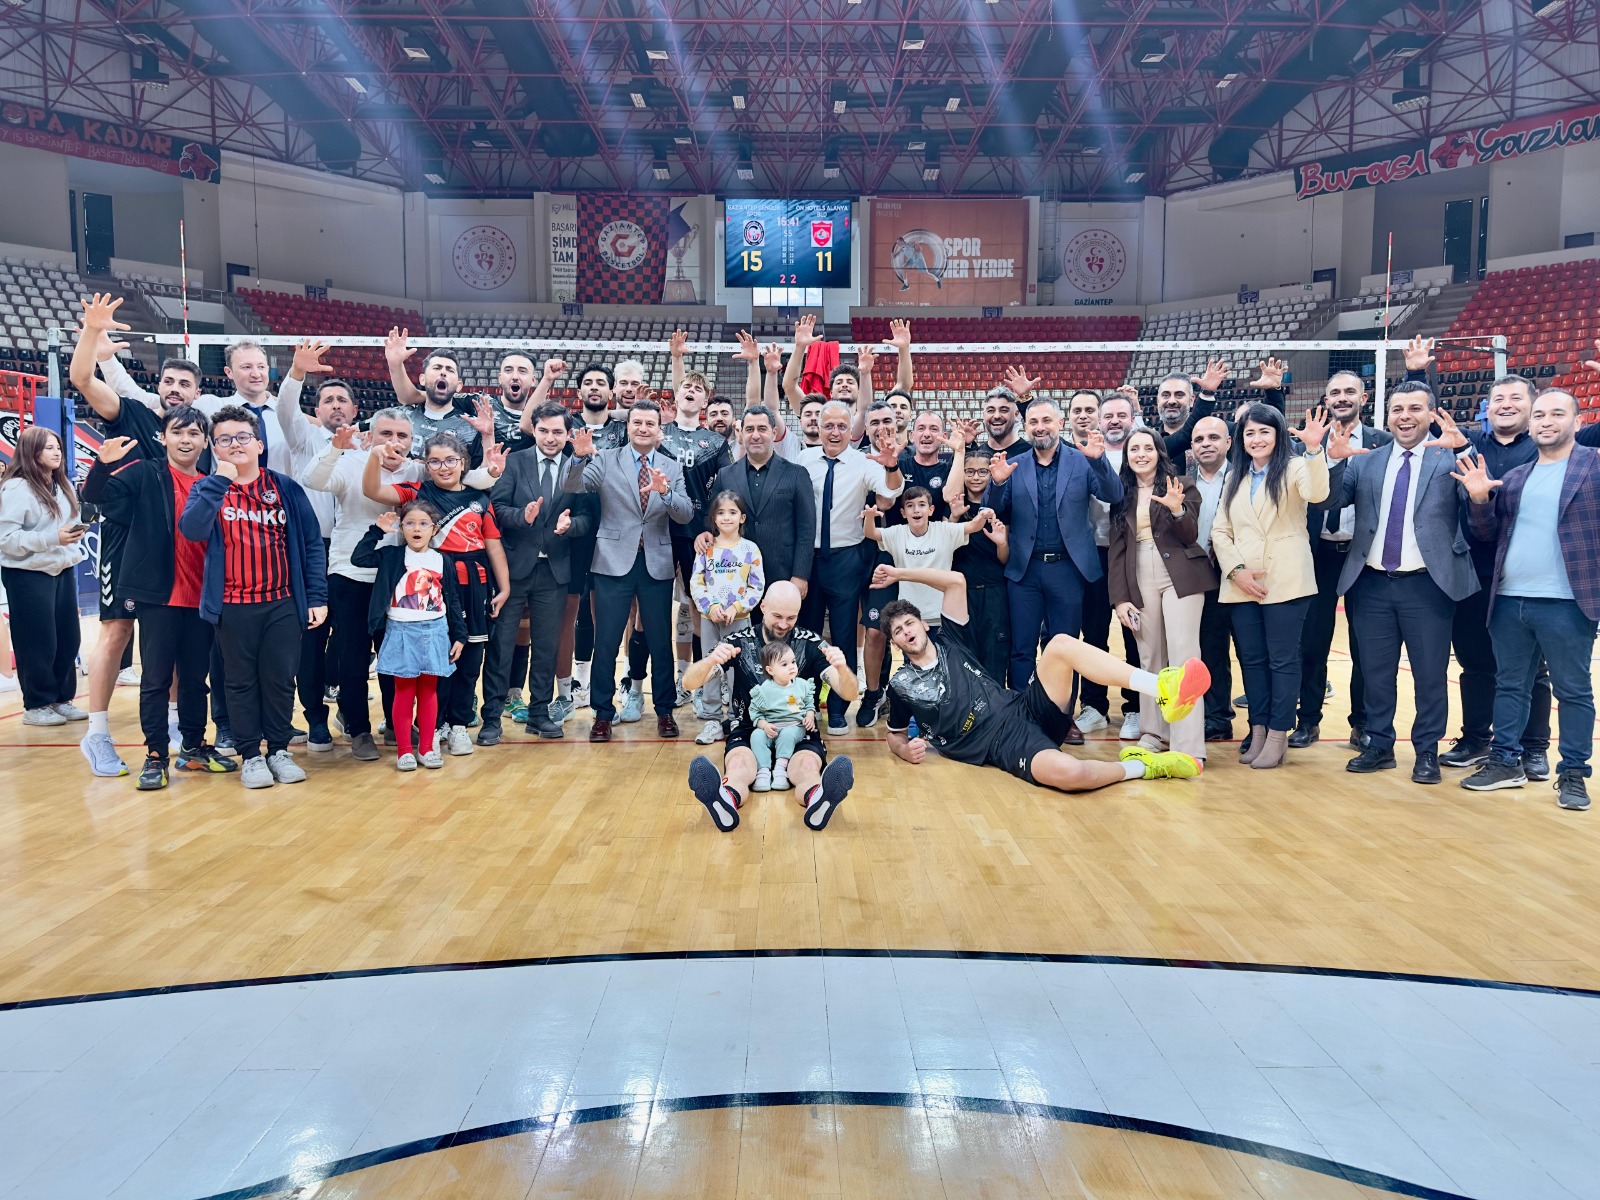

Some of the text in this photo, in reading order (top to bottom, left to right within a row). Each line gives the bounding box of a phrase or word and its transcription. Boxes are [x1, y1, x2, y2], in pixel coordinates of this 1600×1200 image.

[552, 250, 574, 263] TAM
[944, 237, 981, 257] SPOR
[740, 250, 763, 271] 15
[815, 251, 832, 271] 11
[973, 259, 1015, 278] YERDE
[780, 274, 797, 284] 2 2
[677, 447, 695, 468] 28
[223, 506, 287, 525] SANKO
[706, 558, 743, 571] Believe
